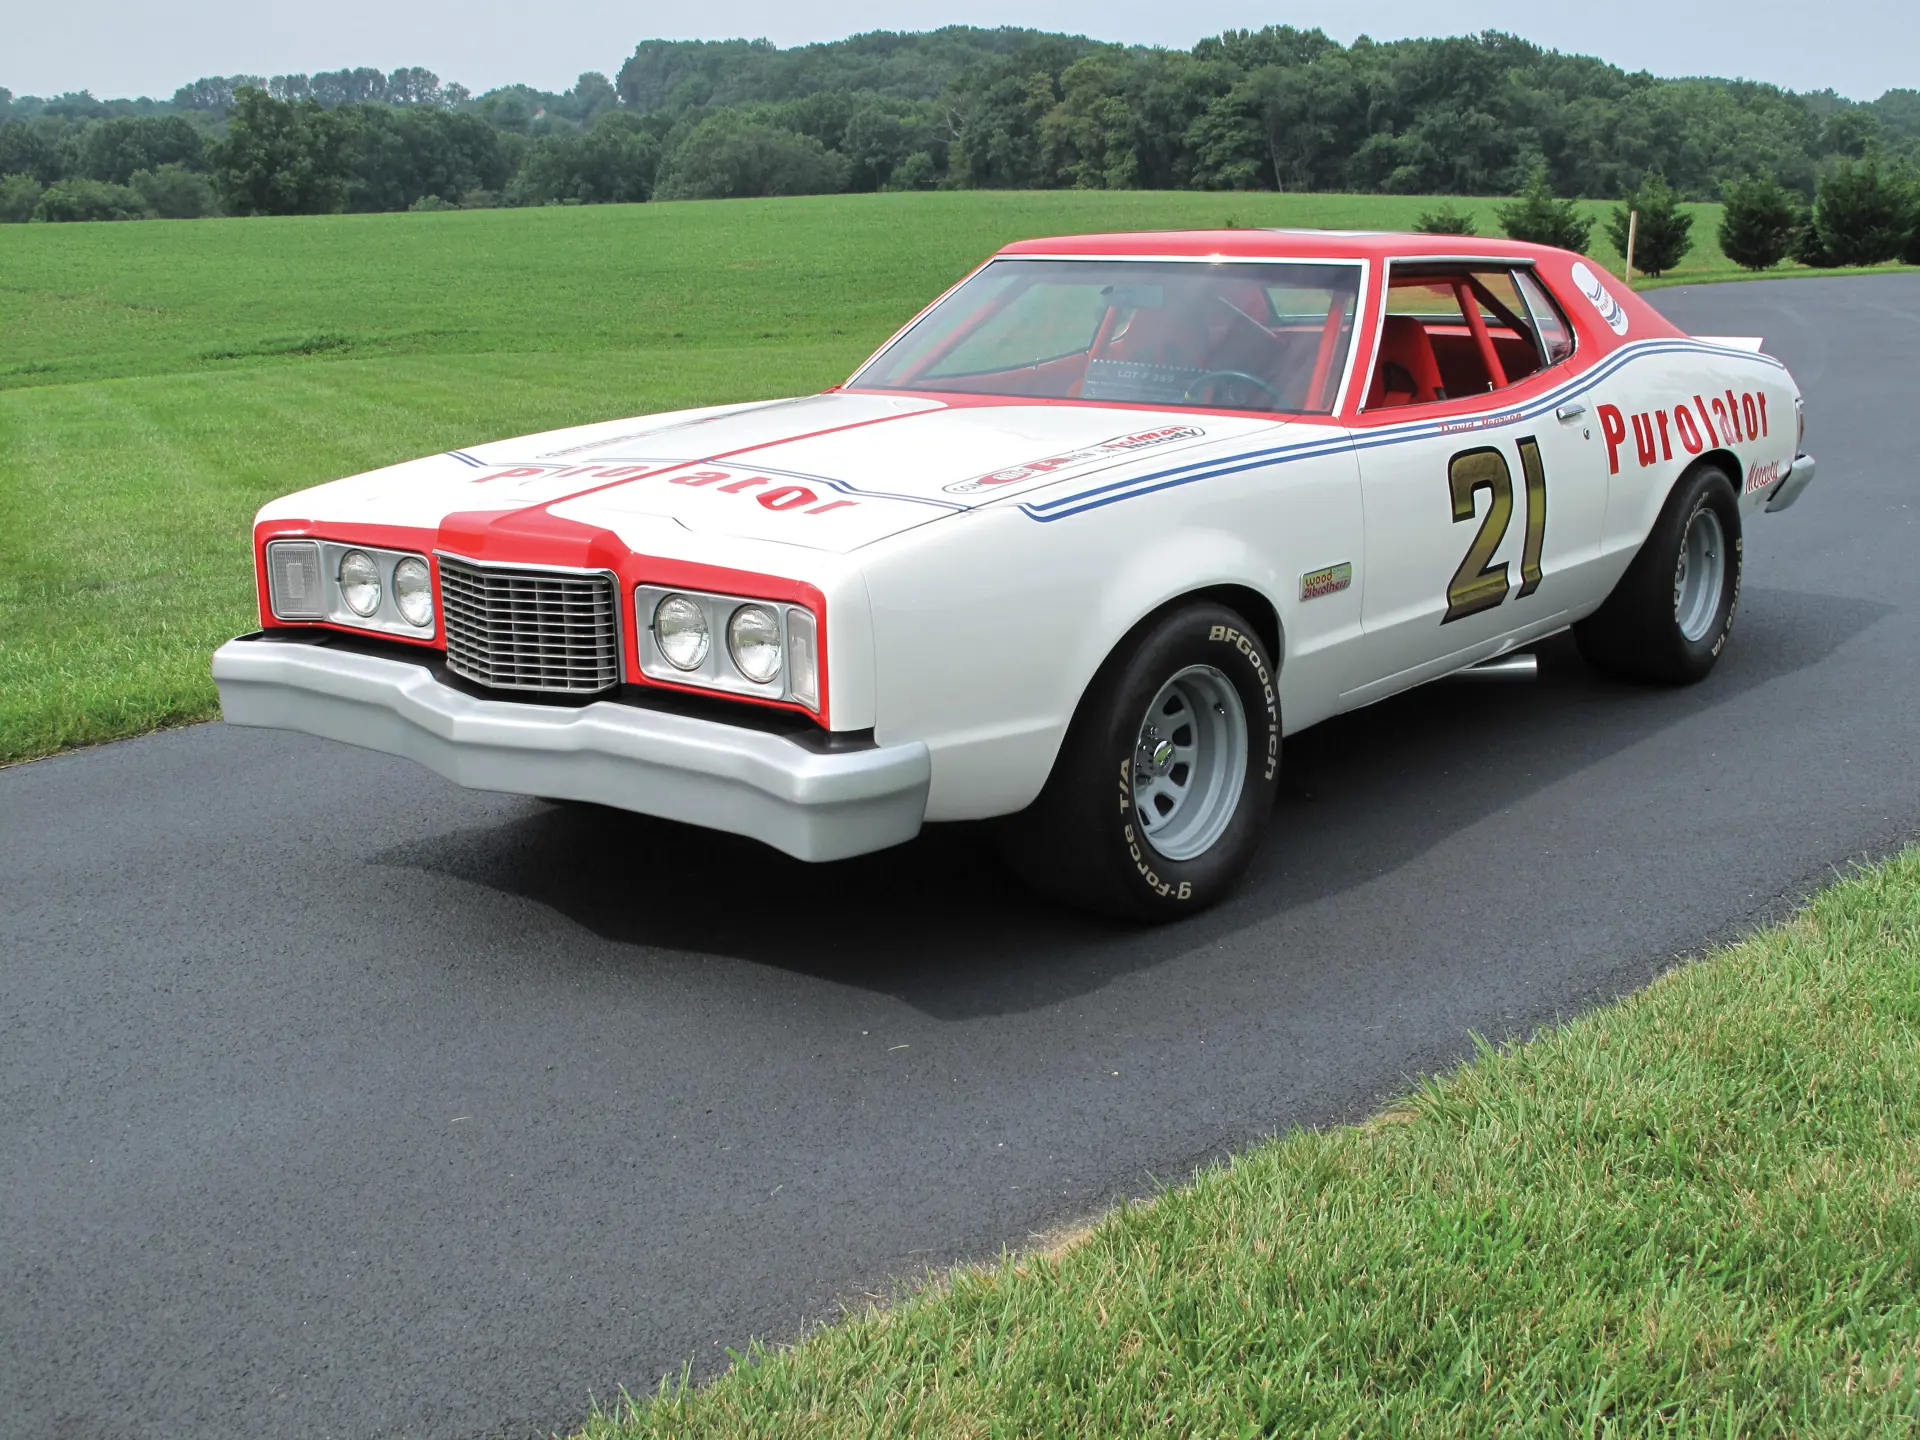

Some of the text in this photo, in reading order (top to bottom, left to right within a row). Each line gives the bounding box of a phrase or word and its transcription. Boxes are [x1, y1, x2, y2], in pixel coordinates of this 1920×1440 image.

[1117, 370, 1138, 379] LOT
[1596, 389, 1768, 475] Purolator
[470, 465, 862, 515] Proator
[1439, 435, 1547, 626] 21
[1305, 568, 1333, 587] wood
[1208, 625, 1280, 781] BFGoodrich
[1119, 757, 1192, 900] g-Force T/A
